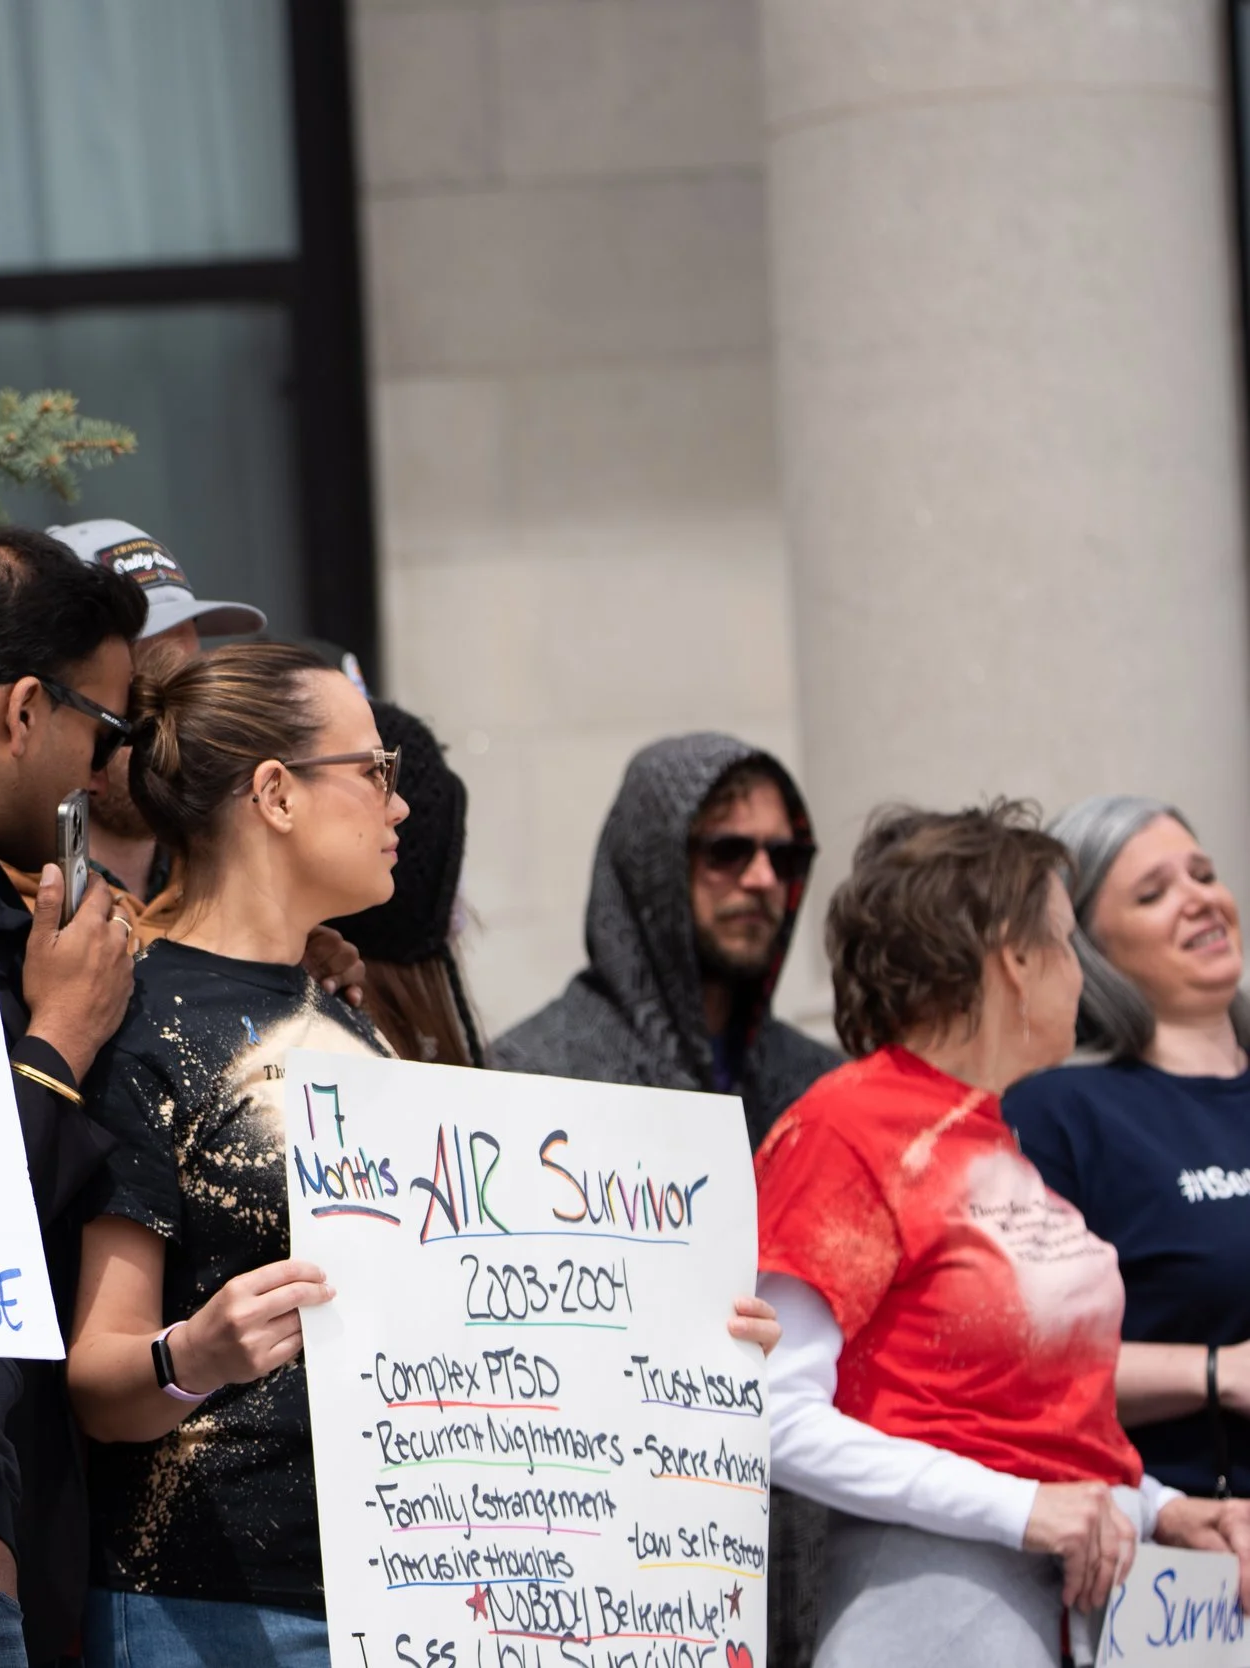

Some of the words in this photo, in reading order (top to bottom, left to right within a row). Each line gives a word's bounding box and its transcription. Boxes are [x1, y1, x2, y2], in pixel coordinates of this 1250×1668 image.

[303, 1082, 346, 1149] 17
[294, 1144, 400, 1201] Months
[409, 1122, 512, 1245] AIR
[539, 1129, 709, 1233] Survivor
[459, 1254, 634, 1322] 2003-2004
[482, 1346, 561, 1400] PTSD
[700, 1365, 763, 1417] Issues
[486, 1412, 626, 1476] Nightmares
[713, 1437, 769, 1515] Anxiety
[471, 1483, 618, 1536] Estrangement
[482, 1543, 575, 1590] thoughts
[594, 1584, 684, 1637] Believed
[687, 1588, 726, 1640] Me!
